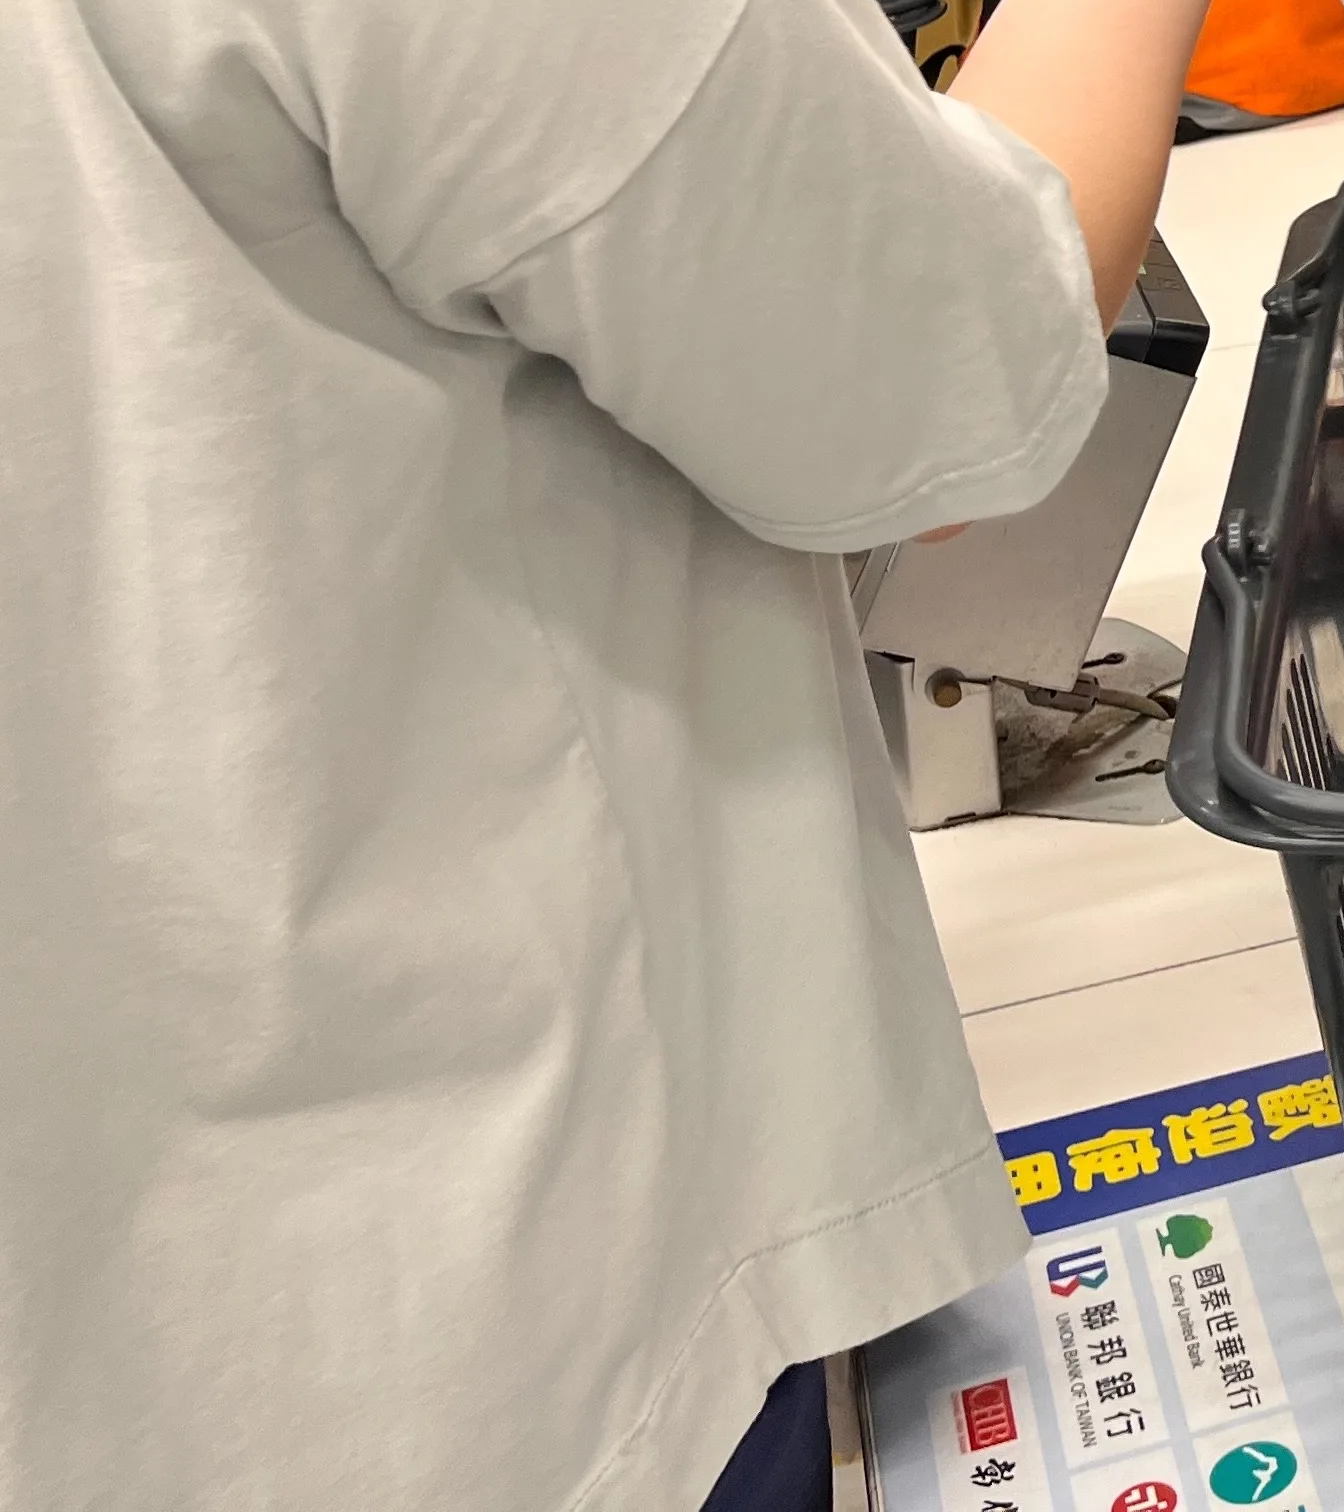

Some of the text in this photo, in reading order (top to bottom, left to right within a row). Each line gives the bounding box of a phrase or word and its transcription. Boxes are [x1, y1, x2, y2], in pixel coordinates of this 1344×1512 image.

[1003, 1075, 1343, 1206] 歡迎使用
[1056, 1312, 1097, 1448] UNION BANK OF TAIWAN
[1080, 1300, 1146, 1437] 聯邦銀行
[1168, 1274, 1205, 1369] Cathay United Bank
[1192, 1263, 1261, 1410] 國泰世華銀行
[968, 1384, 1010, 1448] CHB
